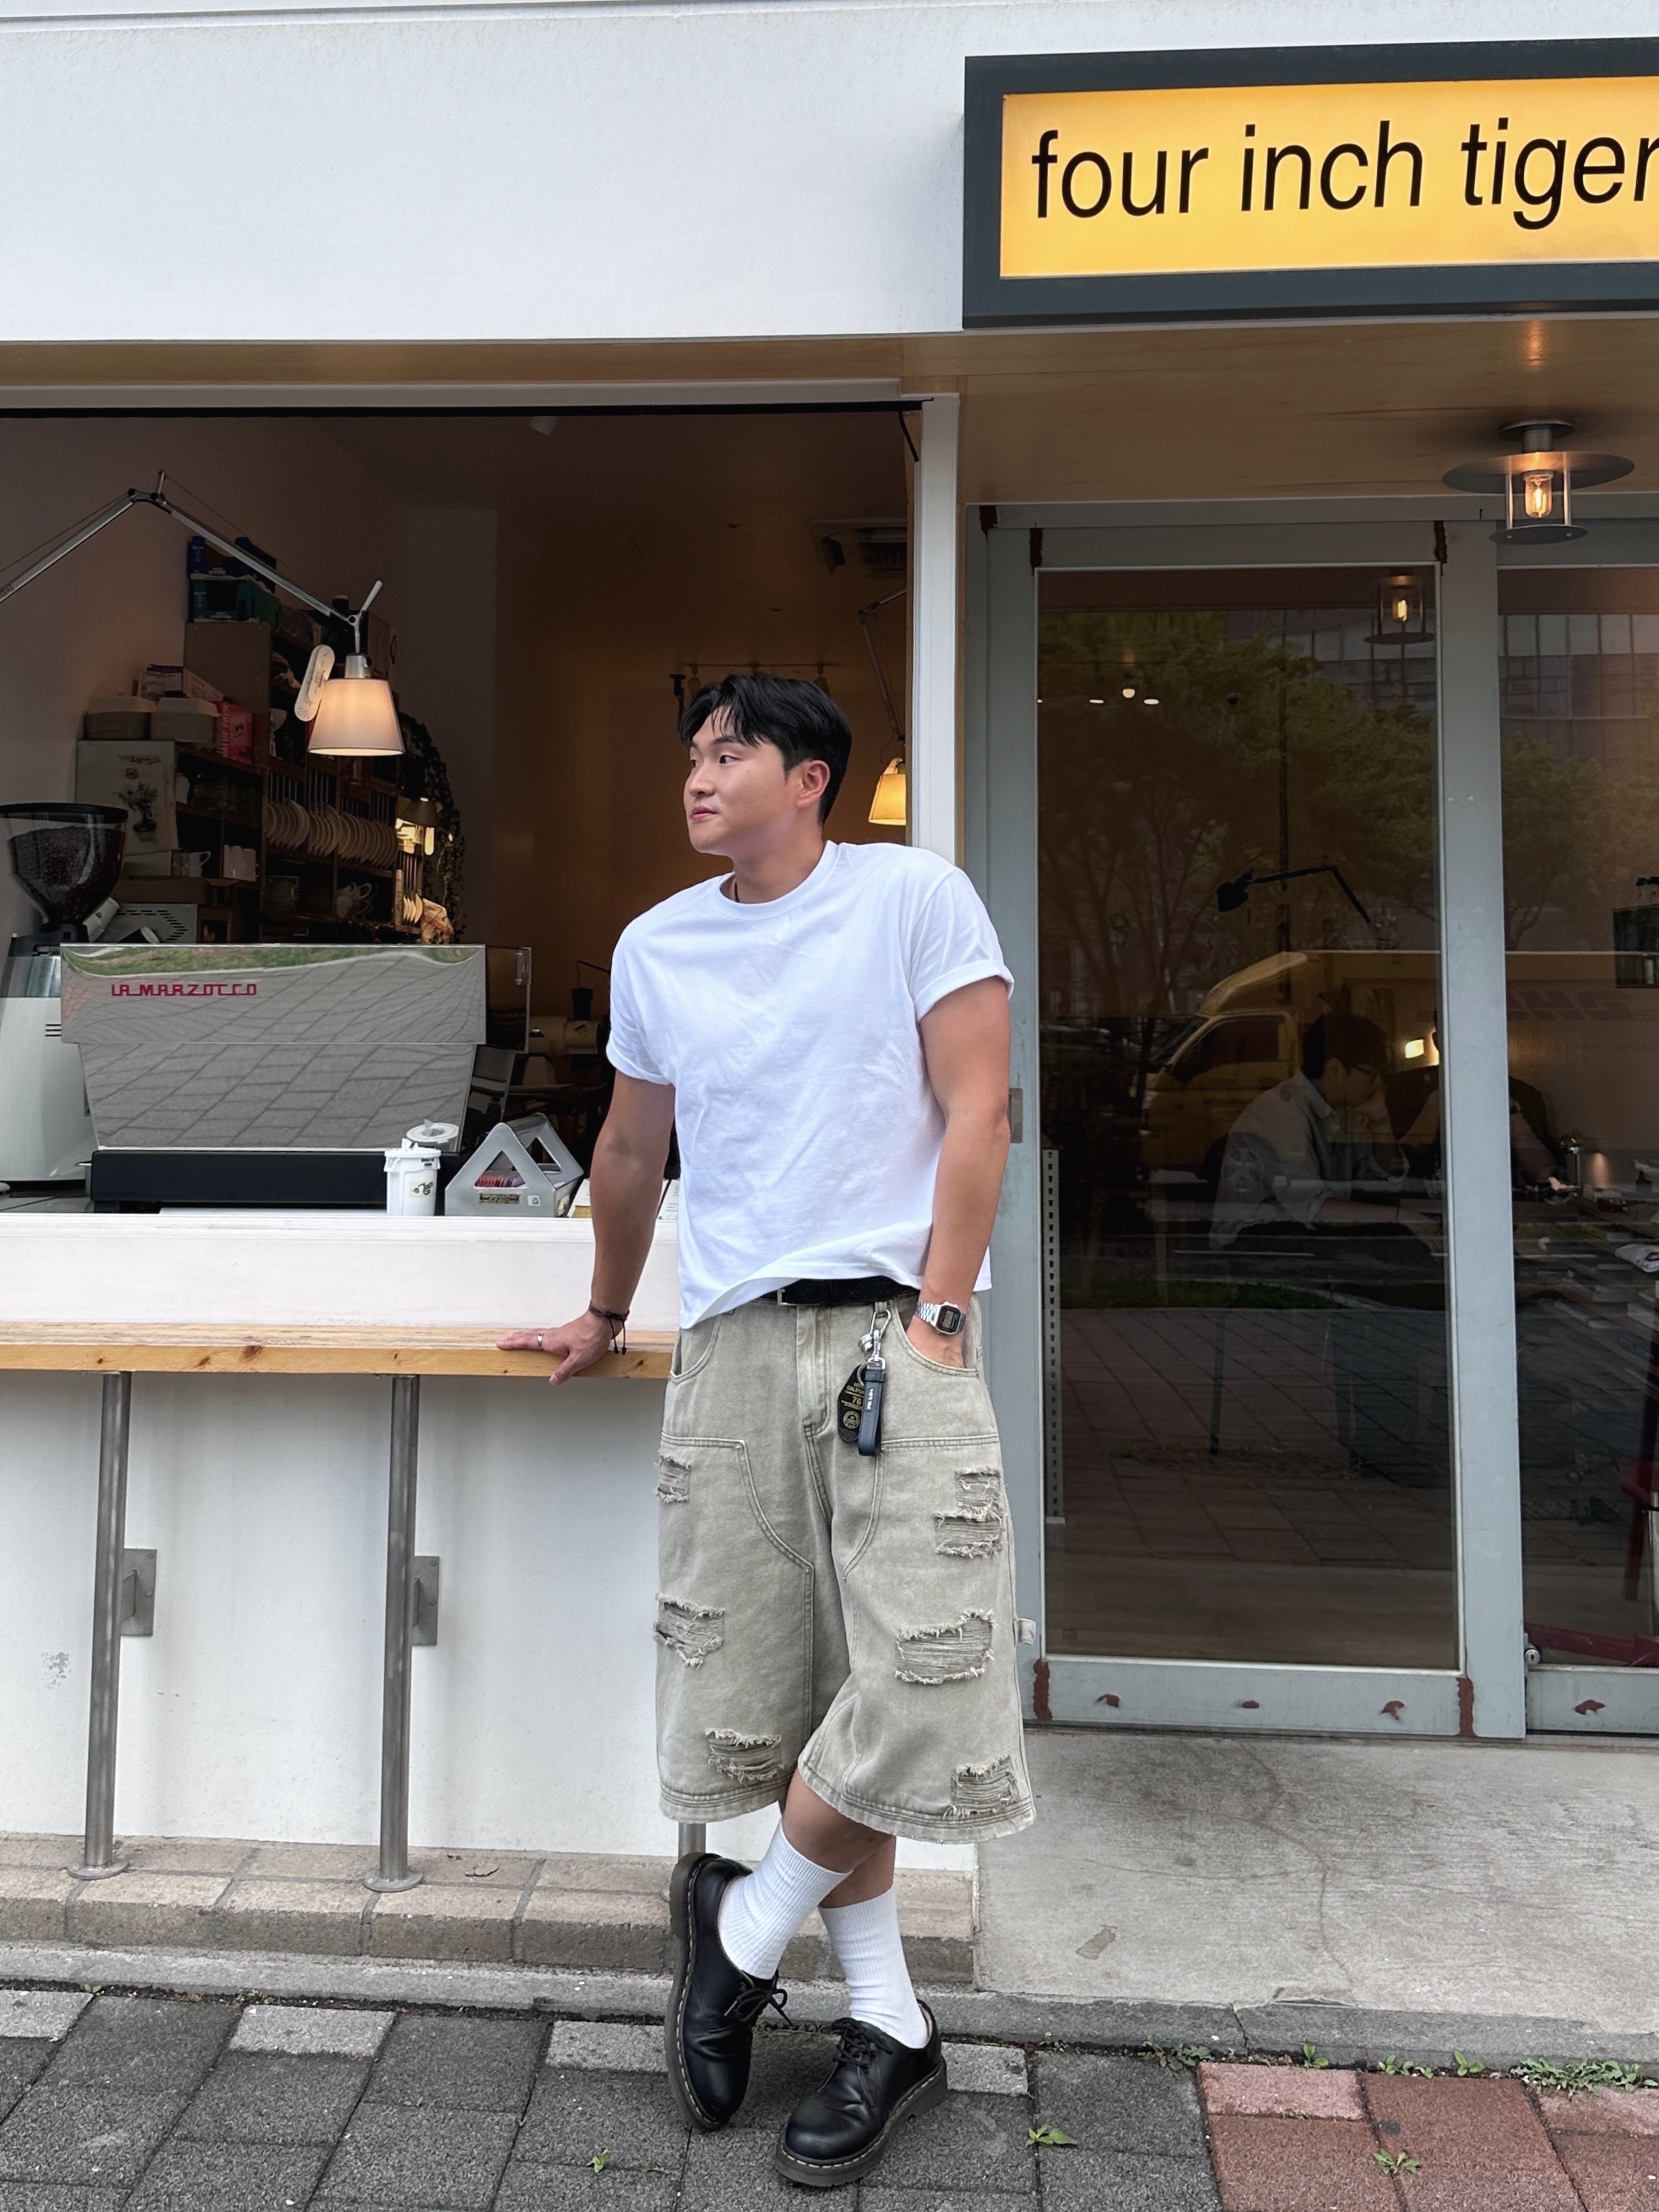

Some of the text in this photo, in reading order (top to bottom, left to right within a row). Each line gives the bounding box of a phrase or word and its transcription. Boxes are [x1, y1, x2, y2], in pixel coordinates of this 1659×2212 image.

[1031, 117, 1659, 231] four inch tiger
[111, 983, 129, 996] LA
